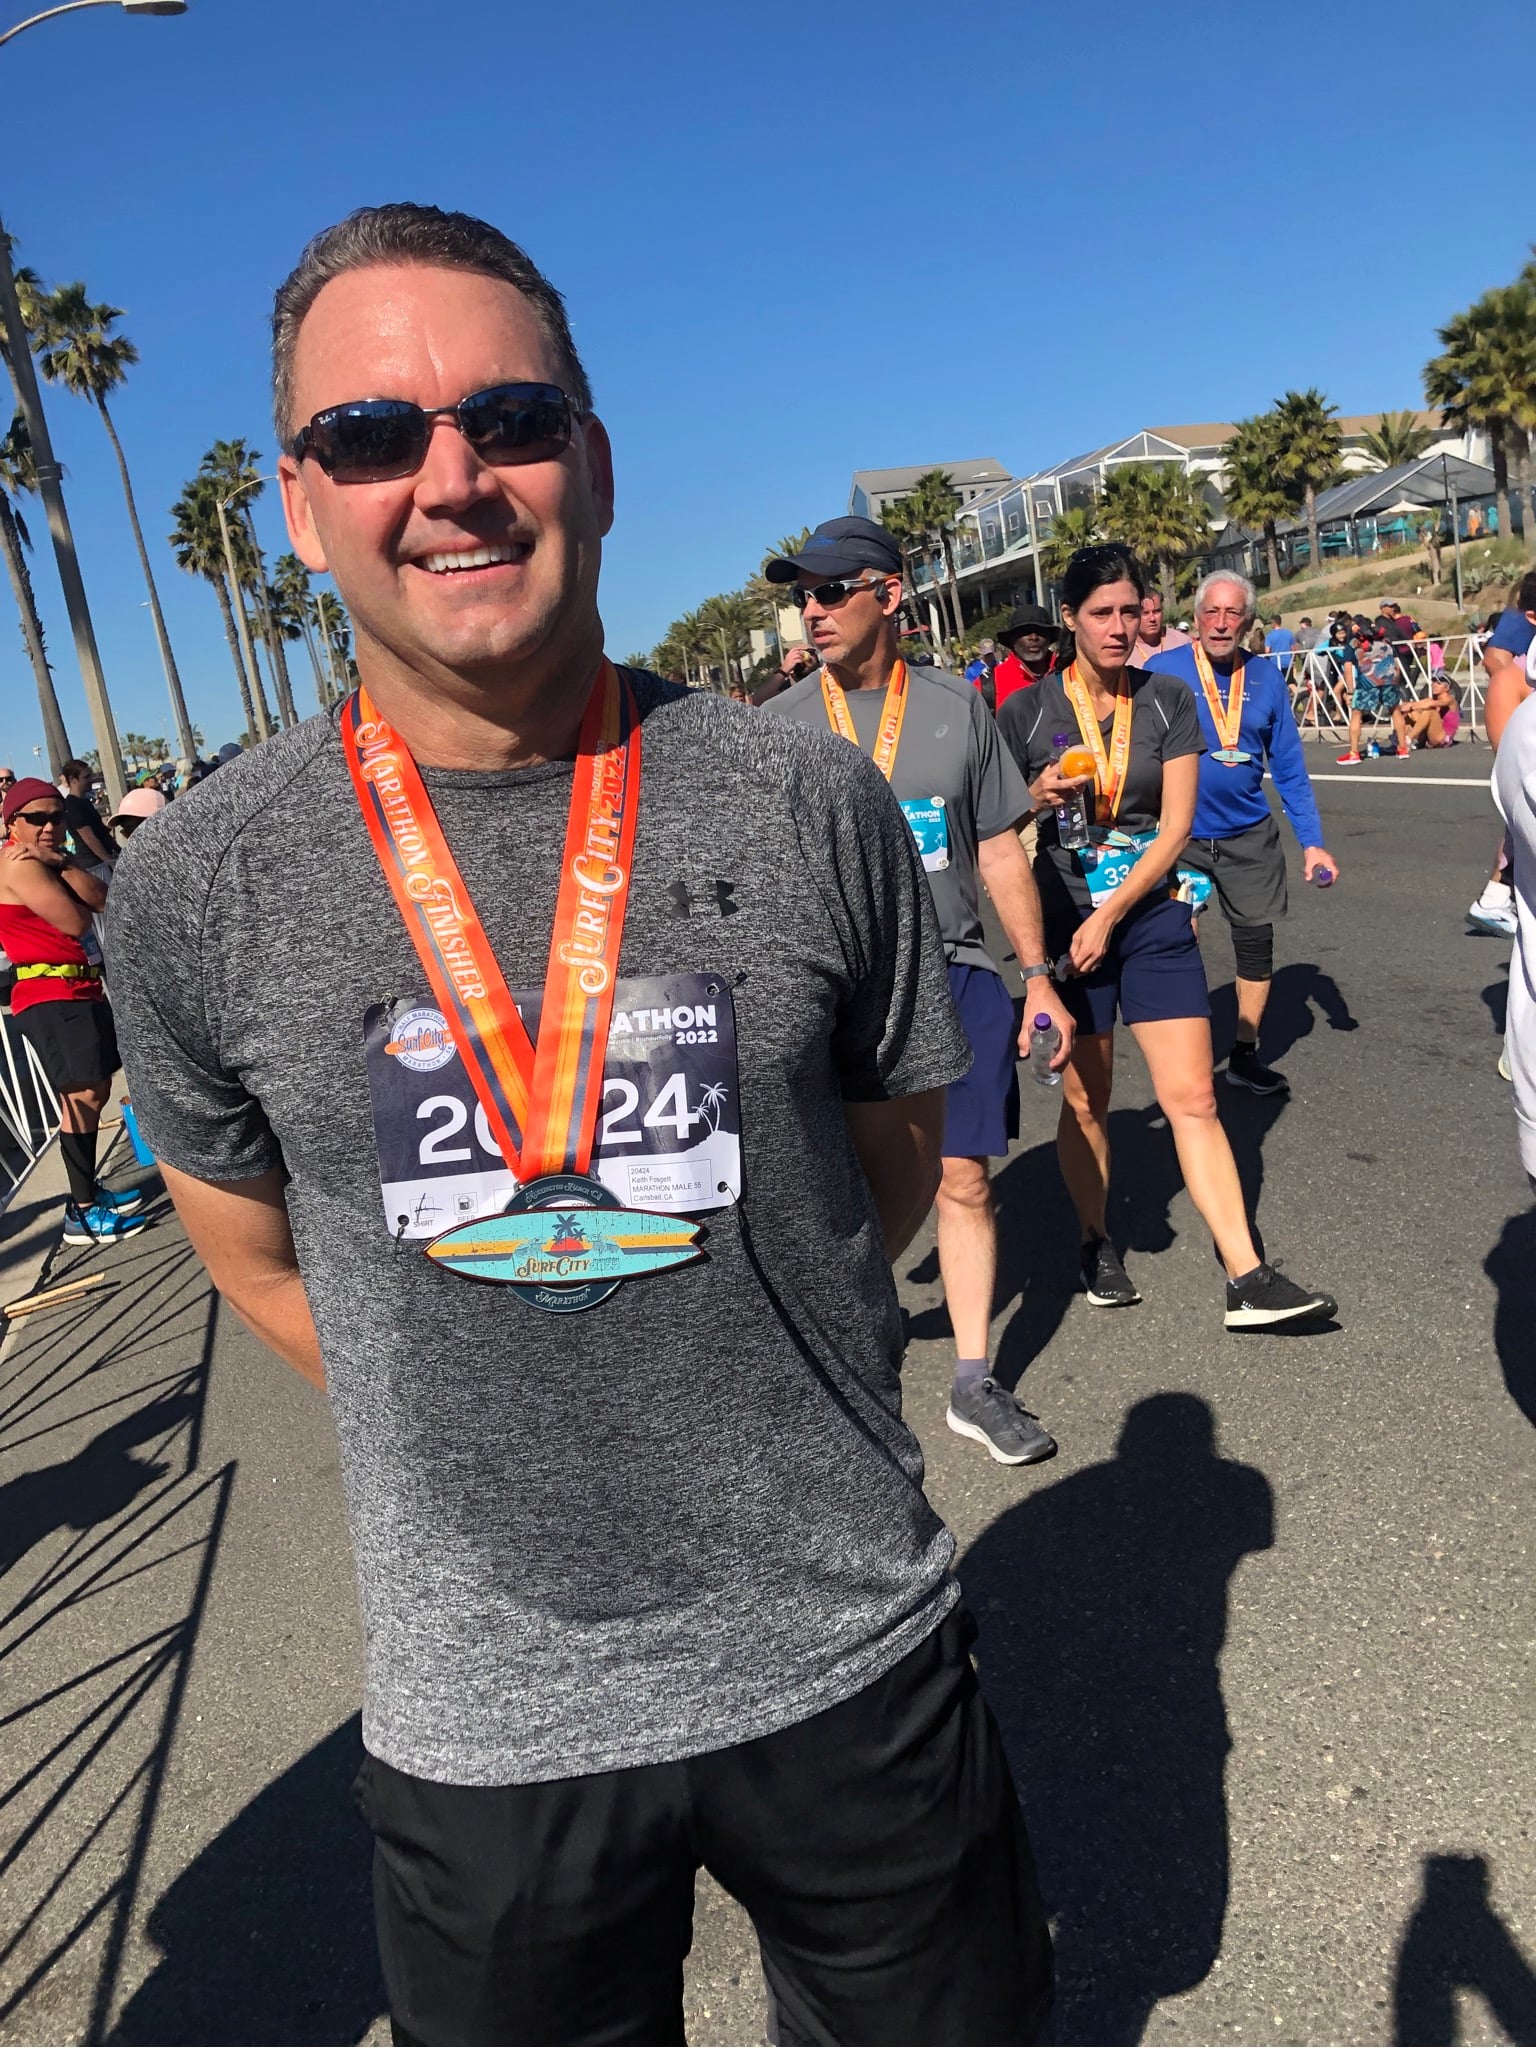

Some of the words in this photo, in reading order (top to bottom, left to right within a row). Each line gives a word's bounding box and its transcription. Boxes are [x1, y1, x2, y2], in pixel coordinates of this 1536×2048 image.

[909, 810, 941, 820] ATHON
[355, 721, 432, 868] MARATHON
[404, 872, 486, 1001] FINISHER
[609, 1005, 717, 1036] ATHON
[675, 1030, 718, 1045] 2022
[672, 1182, 692, 1190] MALE
[413, 1220, 433, 1228] SHIRT
